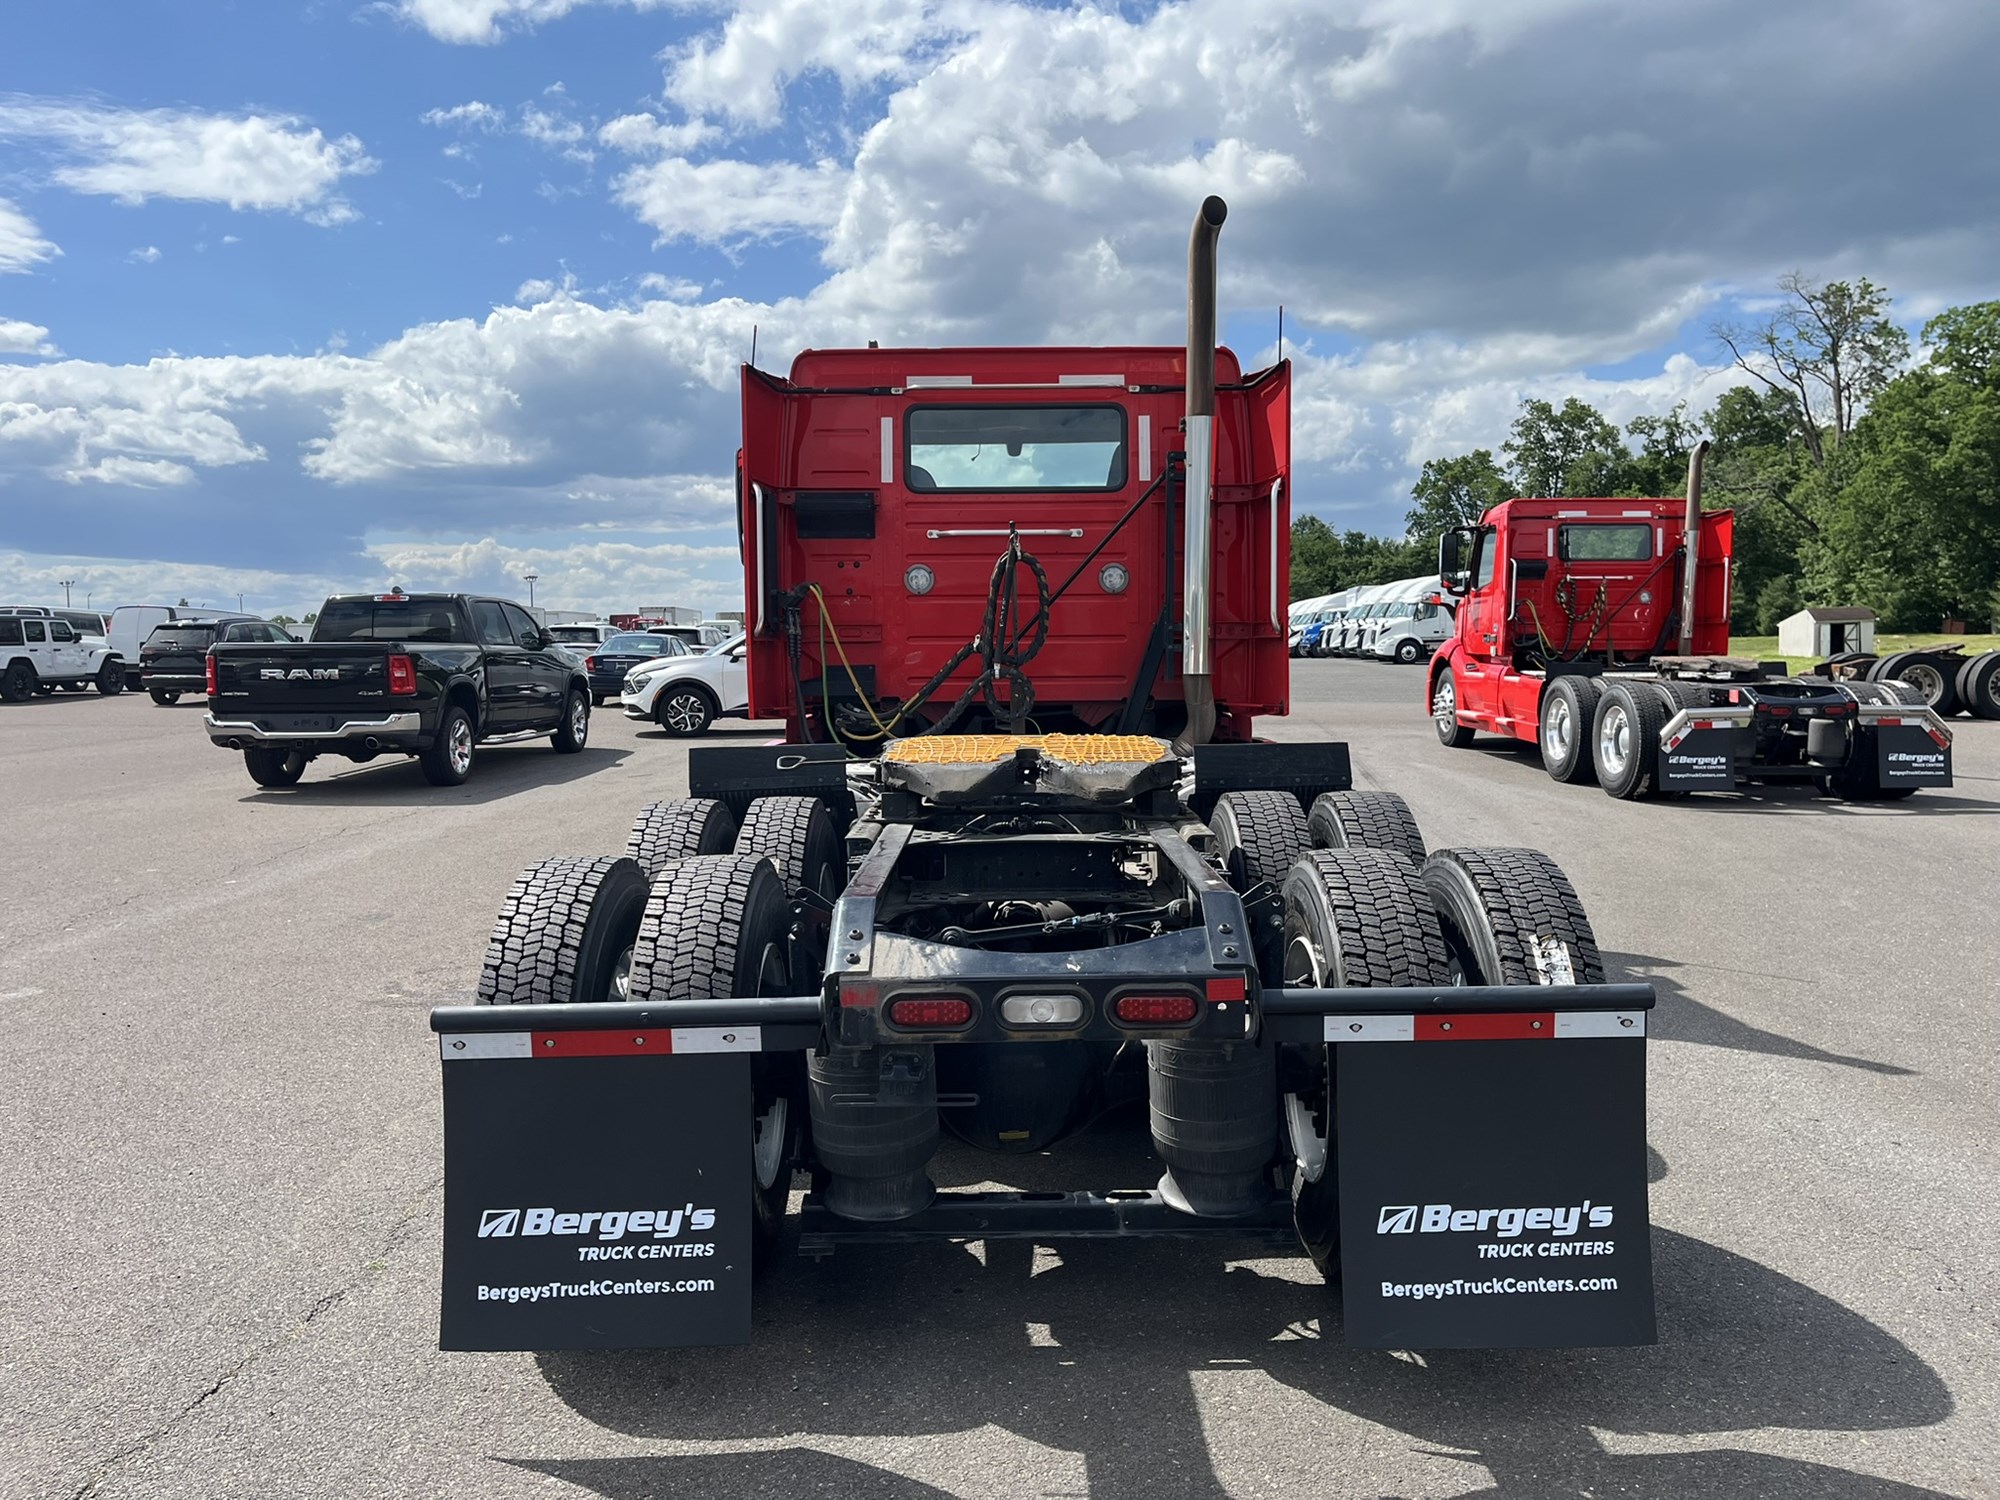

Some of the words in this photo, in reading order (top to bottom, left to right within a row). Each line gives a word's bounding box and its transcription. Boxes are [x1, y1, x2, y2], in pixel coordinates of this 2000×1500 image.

[260, 668, 340, 681] RAM
[1679, 755, 1727, 765] Bergey's
[1898, 753, 1945, 763] Bergey's
[521, 1202, 716, 1241] Bergey's
[1419, 1200, 1614, 1238] Bergey's
[577, 1245, 636, 1262] TRUCK
[637, 1243, 716, 1260] CENTERS
[1477, 1243, 1534, 1259] TRUCK
[1537, 1240, 1615, 1257] CENTERS
[477, 1278, 715, 1304] BergeysTruckCenters.com
[1381, 1276, 1618, 1300] BergeysTruckCenters.com
